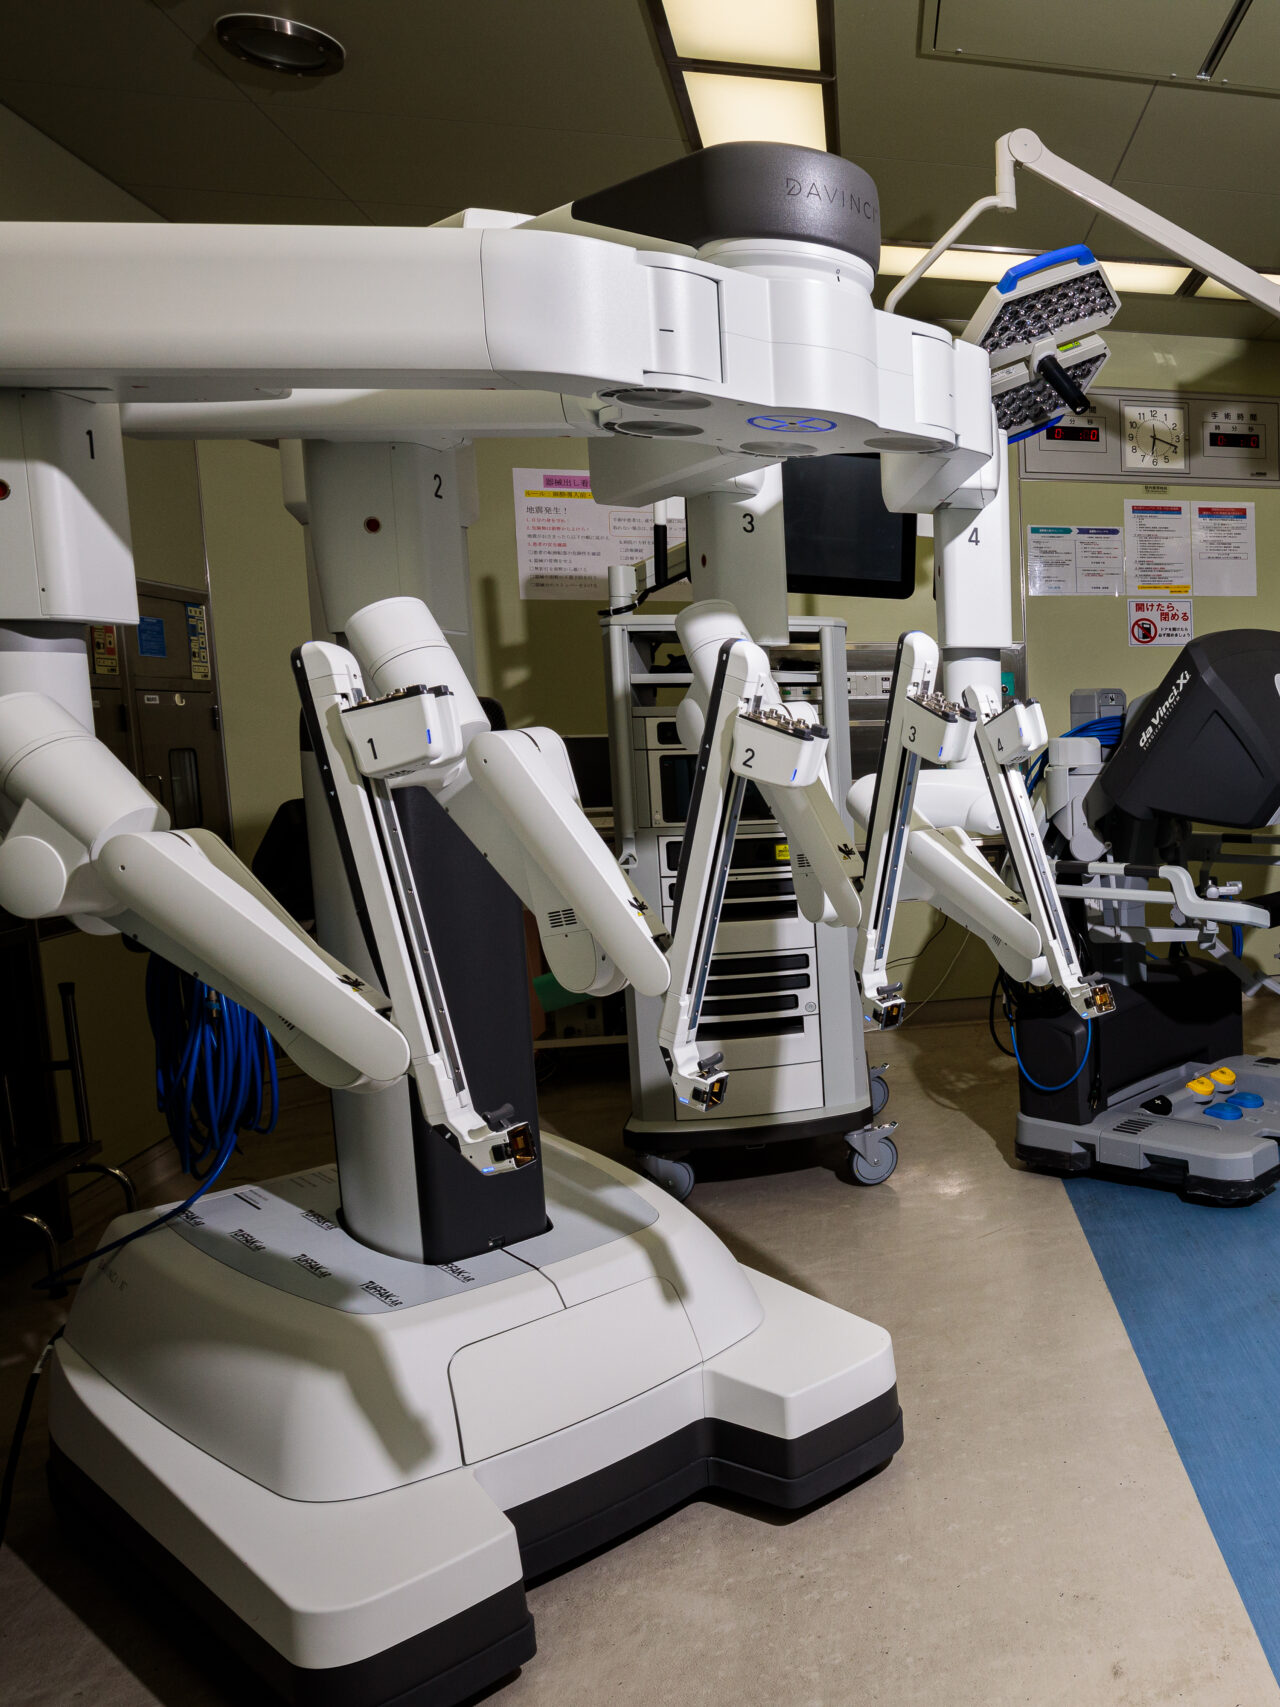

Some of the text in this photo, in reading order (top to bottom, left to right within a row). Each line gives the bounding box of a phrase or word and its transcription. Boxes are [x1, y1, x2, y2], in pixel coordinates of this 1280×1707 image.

[785, 177, 877, 223] DAVINCI
[1138, 412, 1145, 420] 11
[1150, 409, 1158, 418] 12
[1164, 413, 1168, 421] 1
[1129, 420, 1138, 430] 10
[1172, 422, 1178, 431] 2
[1128, 433, 1134, 442] 9
[1175, 434, 1181, 443] 3
[86, 429, 96, 460] 1
[1131, 445, 1138, 454] 8
[1140, 454, 1146, 463] 7
[1152, 458, 1159, 467] 6
[1163, 455, 1170, 464] 5
[433, 473, 443, 499] 2
[742, 513, 755, 534] 3
[967, 526, 981, 546] 4
[1135, 602, 1179, 613] 開けたら、
[1160, 611, 1190, 622] 閉める
[1139, 670, 1190, 747] da Vinci Xi
[907, 725, 917, 743] 3
[365, 737, 378, 760] 1
[997, 737, 1004, 753] 4
[742, 747, 755, 769] 2
